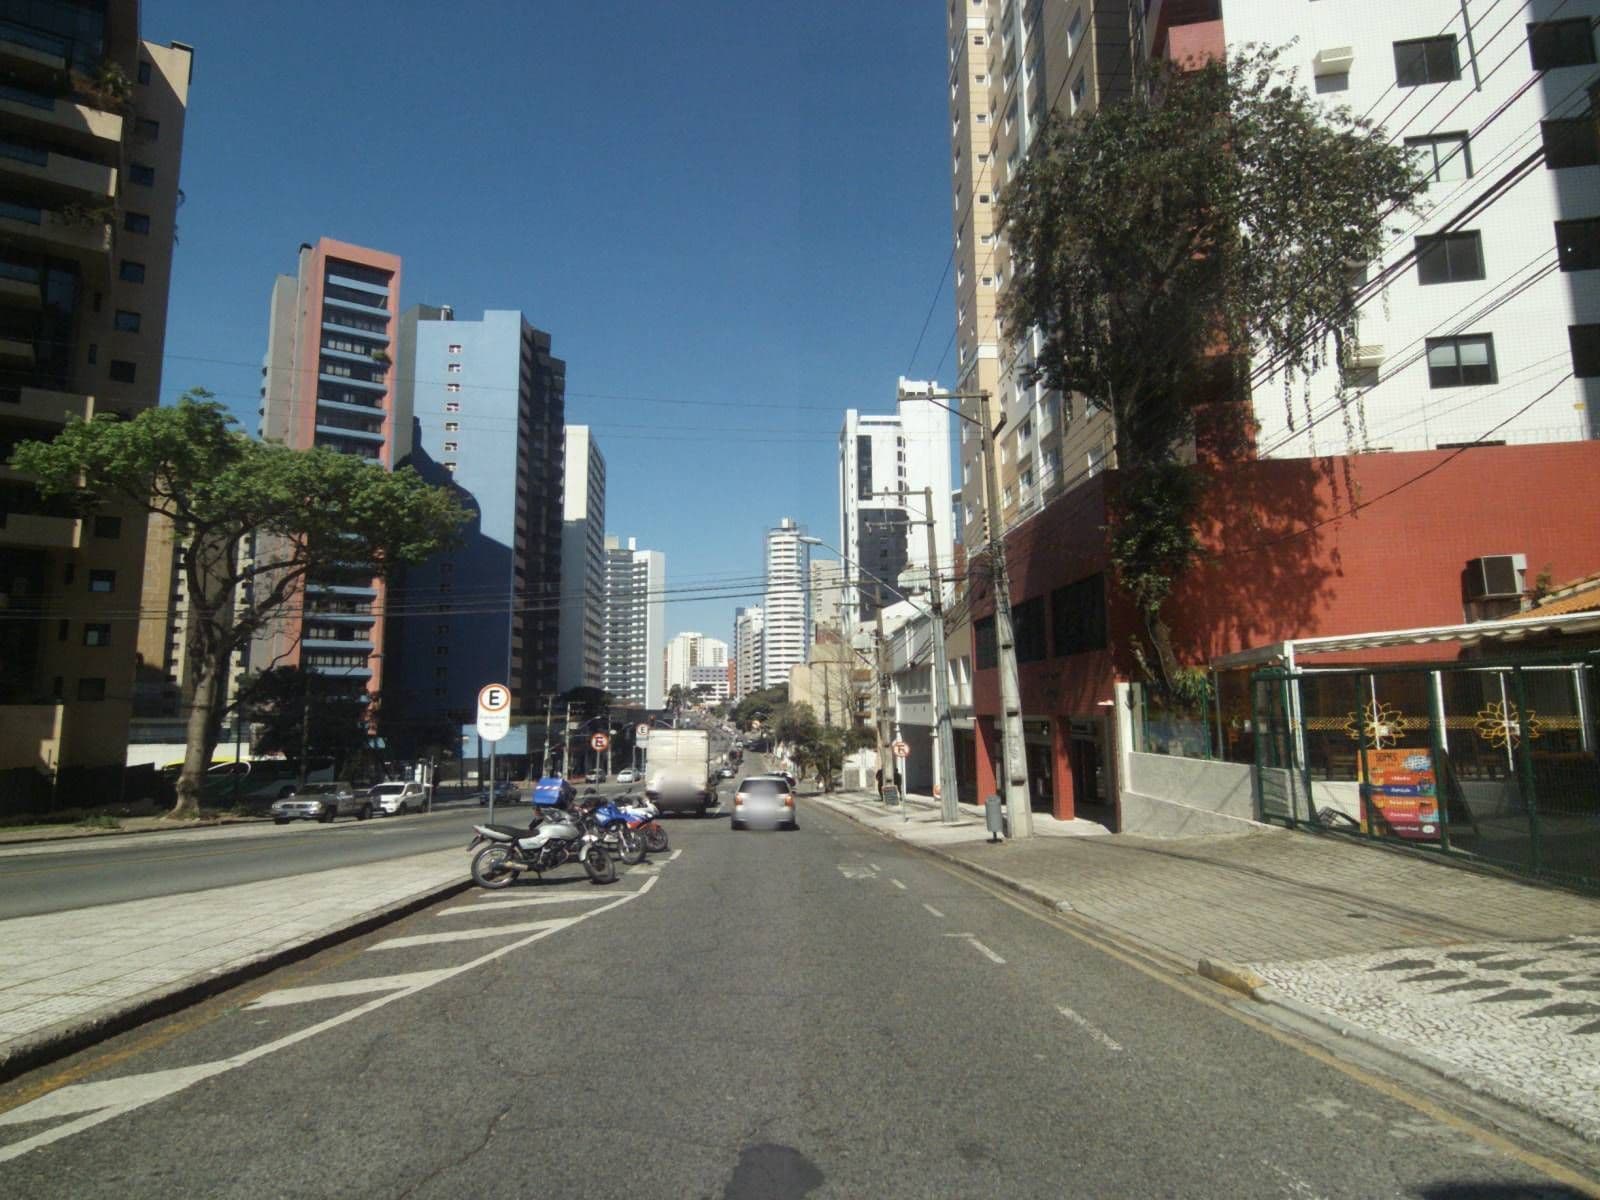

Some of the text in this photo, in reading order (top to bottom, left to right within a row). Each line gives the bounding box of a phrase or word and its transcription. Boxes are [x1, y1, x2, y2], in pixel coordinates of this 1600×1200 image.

[489, 690, 500, 706] E
[640, 726, 646, 734] E
[595, 736, 604, 748] E
